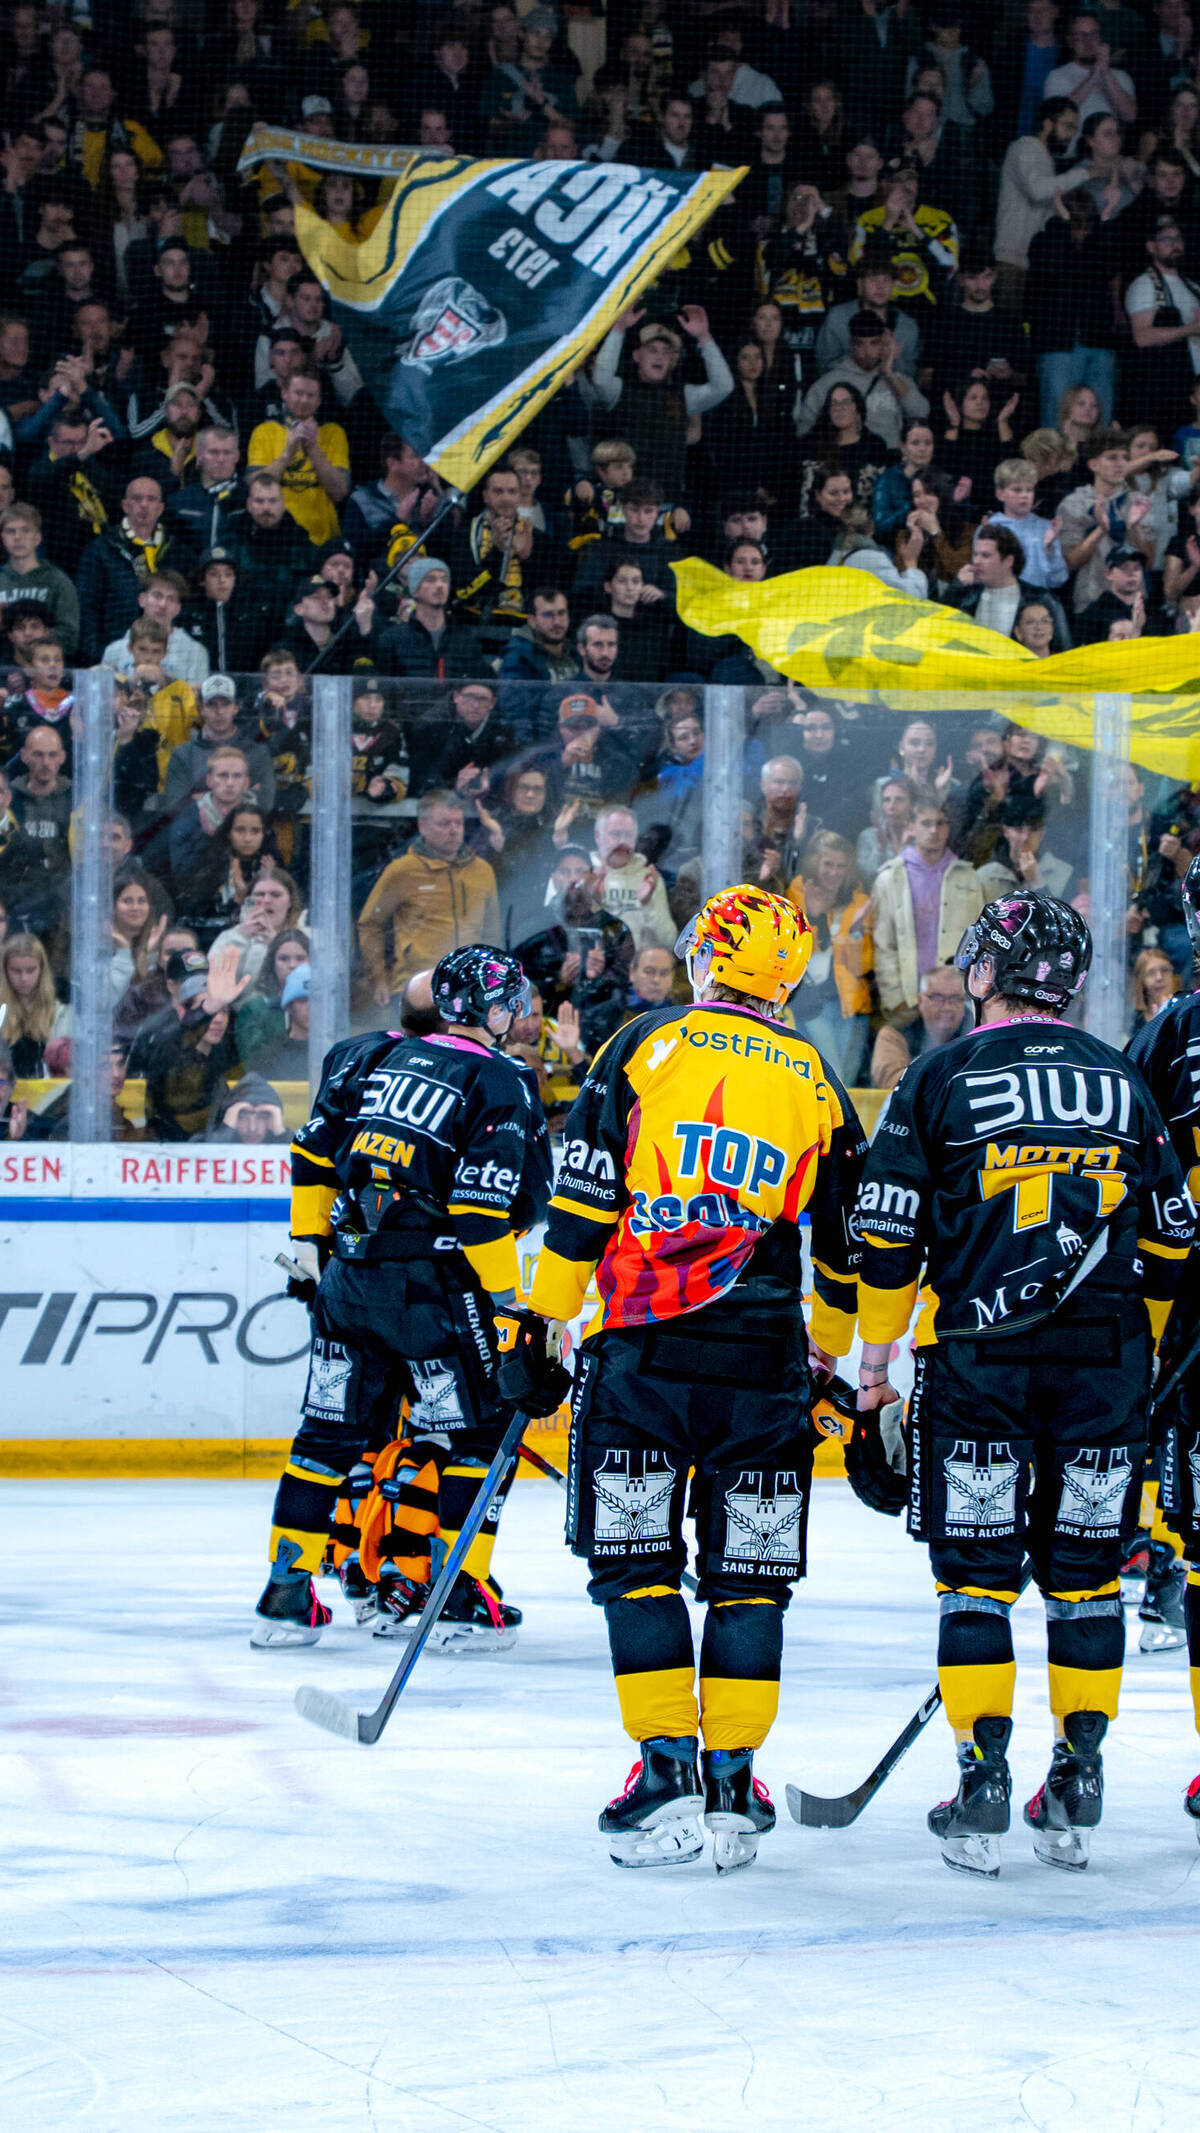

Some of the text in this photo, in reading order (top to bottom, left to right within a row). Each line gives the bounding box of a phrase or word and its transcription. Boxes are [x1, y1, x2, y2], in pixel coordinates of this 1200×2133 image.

[300, 139, 388, 166] HOCKEY
[673, 1121, 788, 1197] TOP
[984, 1143, 1122, 1170] MOTTET
[121, 1157, 292, 1185] RAIFFEISEN
[1020, 1209, 1044, 1221] CCM
[434, 1420, 467, 1431] ALCOOL
[911, 1427, 923, 1532] RICHARD
[945, 1524, 1015, 1538] SANS ALCOOL
[1083, 1526, 1120, 1539] ALCOOL
[594, 1542, 673, 1556] SANS ALCOOL
[721, 1561, 798, 1577] SANS ALCOOL
